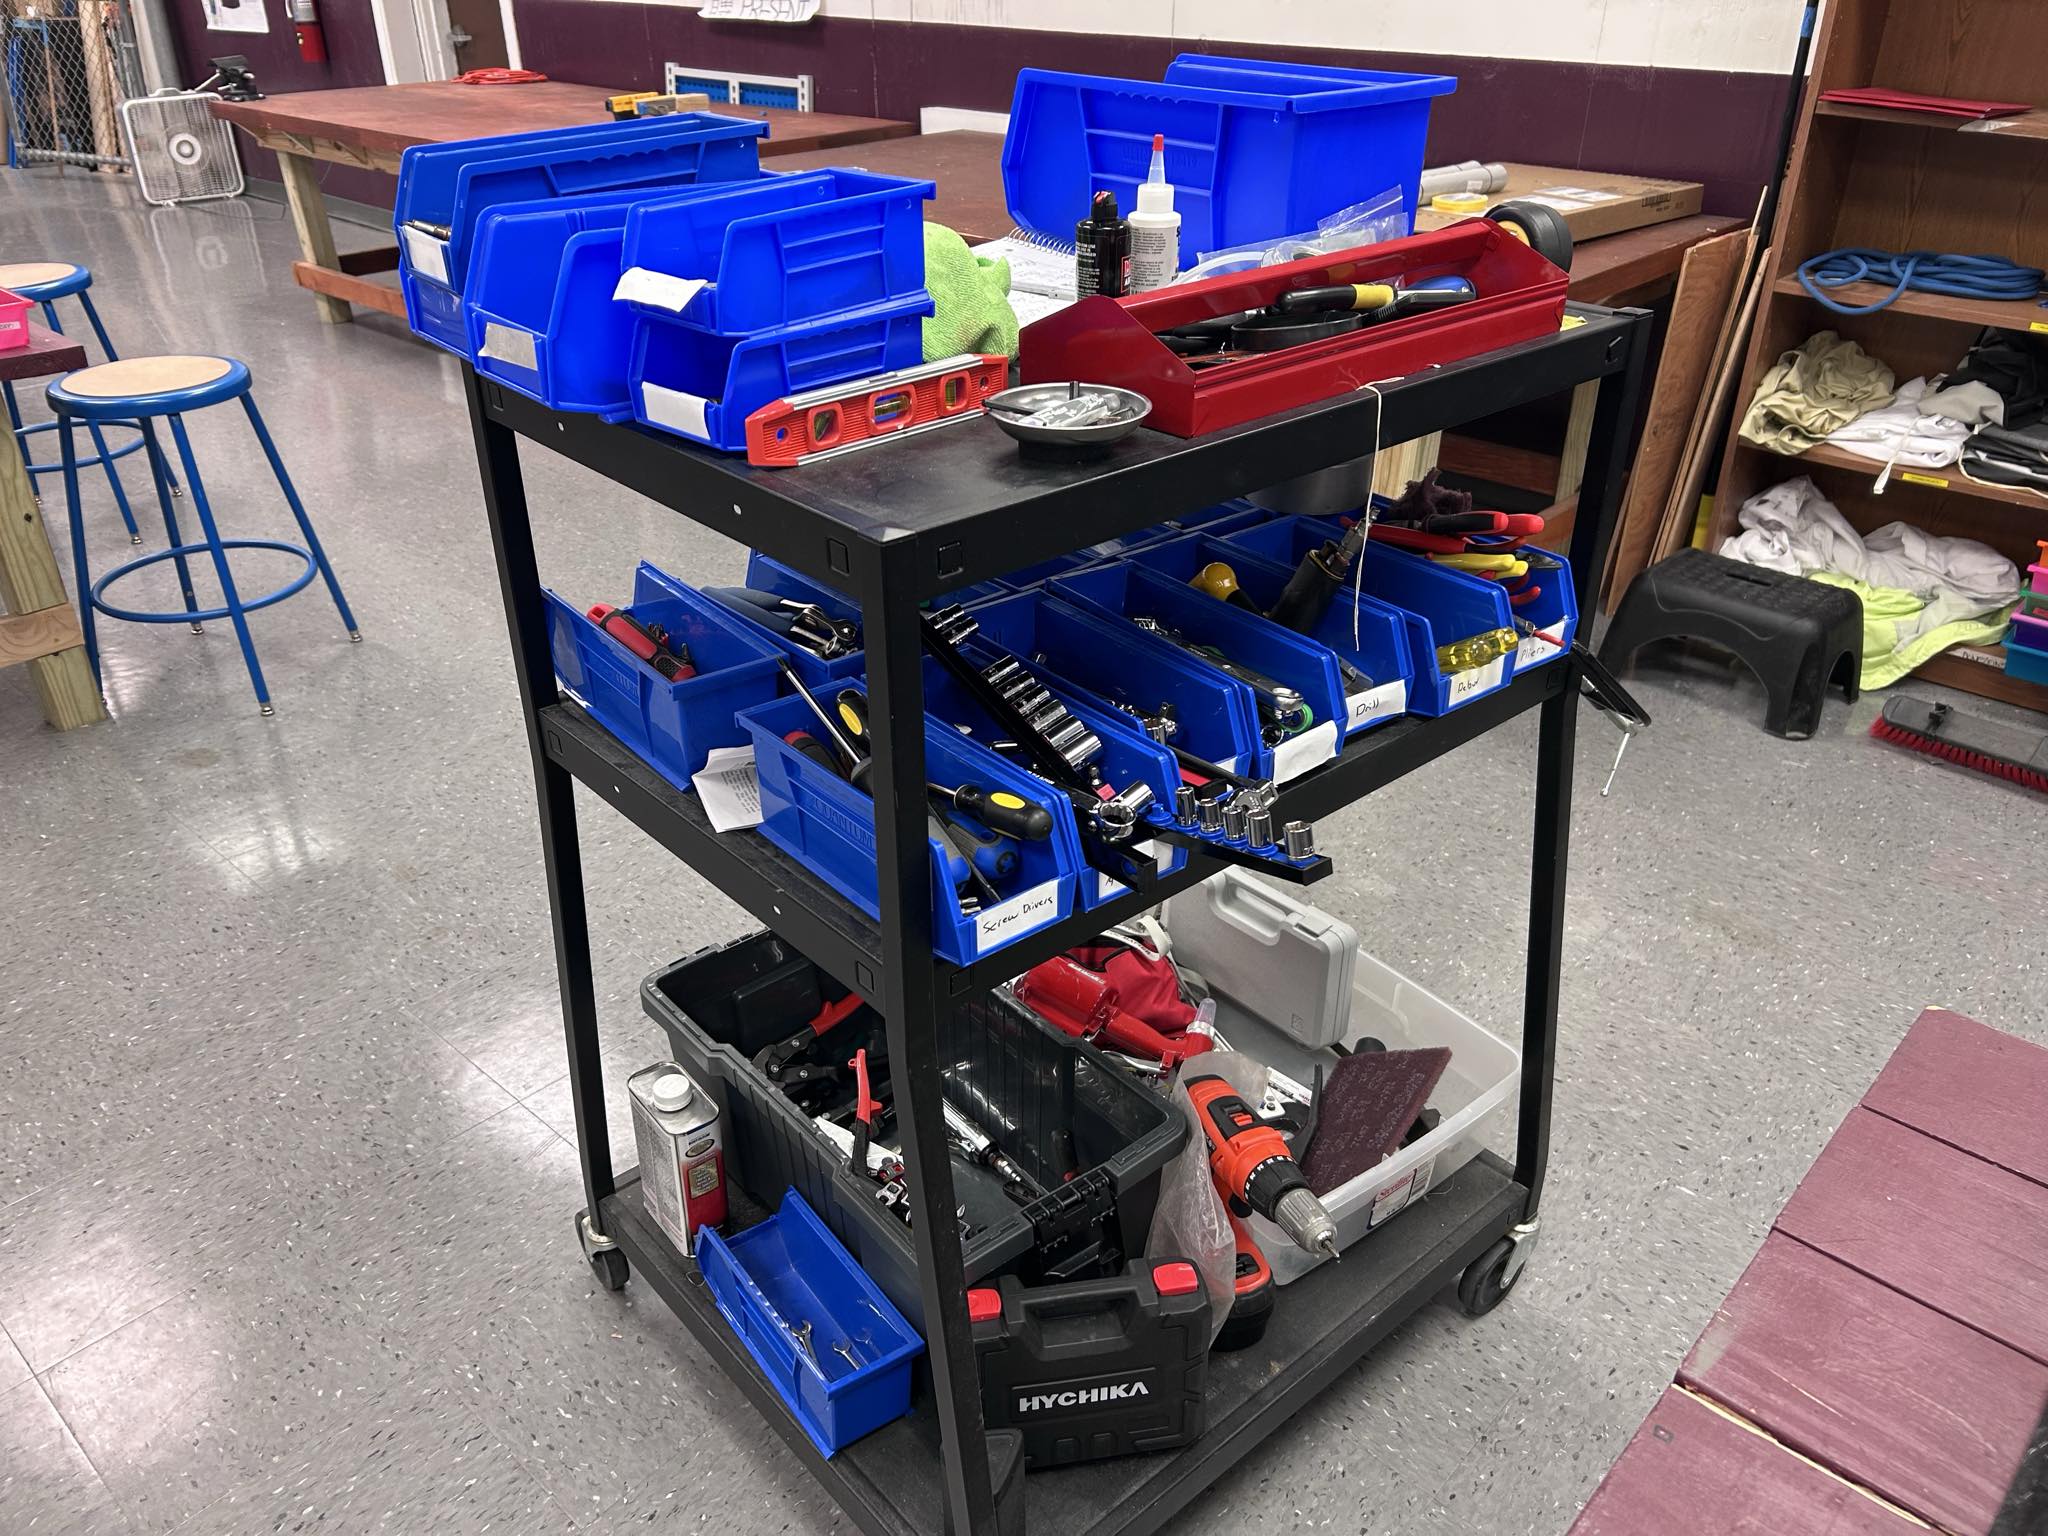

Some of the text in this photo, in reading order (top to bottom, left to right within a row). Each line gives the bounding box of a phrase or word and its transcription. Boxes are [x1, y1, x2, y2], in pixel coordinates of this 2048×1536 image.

[740, 0, 811, 20] PRESENT
[1520, 645, 1545, 661] Pliers
[1356, 697, 1379, 717] Drill
[982, 896, 1054, 934] Screw Drivers
[1019, 1381, 1150, 1412] HYCHIKA
